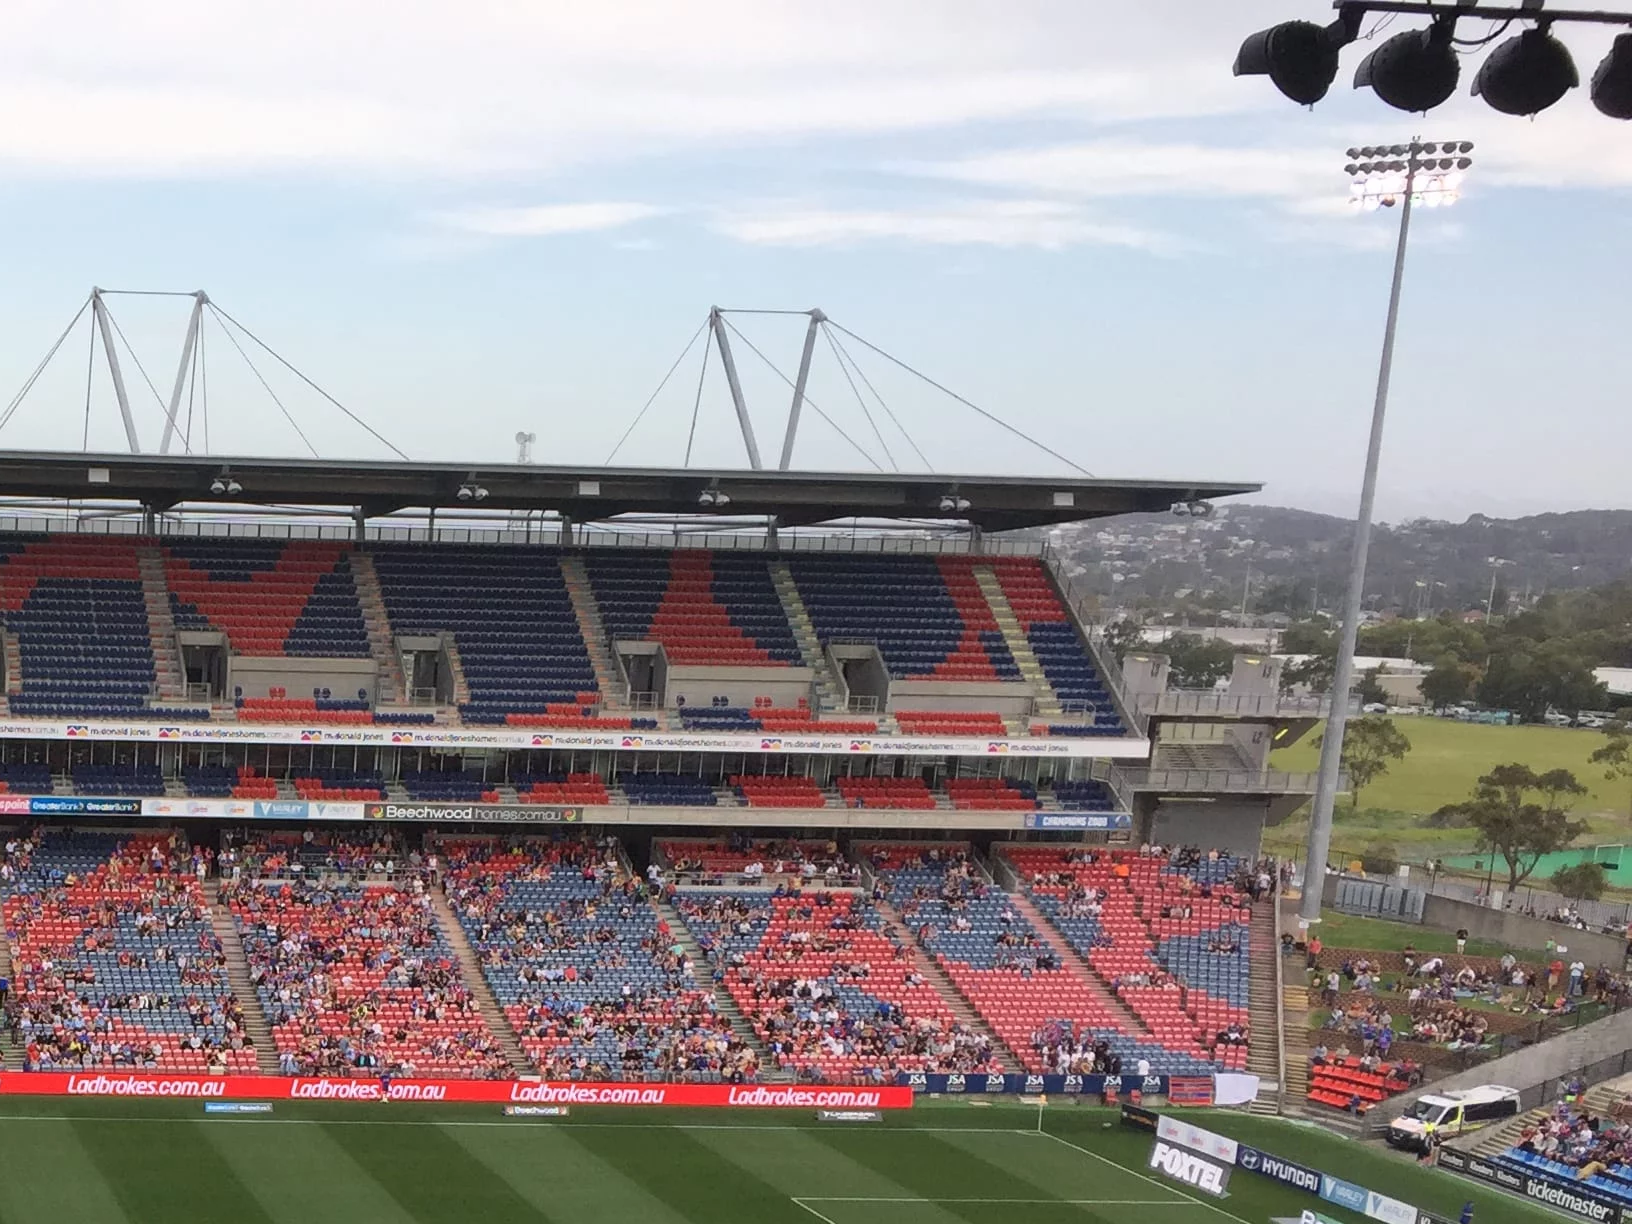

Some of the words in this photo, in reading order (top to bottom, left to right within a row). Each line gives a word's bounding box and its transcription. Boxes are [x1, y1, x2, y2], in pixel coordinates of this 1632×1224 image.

[386, 805, 472, 820] Beechwood
[908, 1074, 927, 1084] JSA
[947, 1075, 965, 1085] JSA
[986, 1075, 1005, 1085] JSA
[1025, 1075, 1044, 1085] JSA
[1065, 1075, 1083, 1085] JSA
[1103, 1075, 1122, 1085] JSA
[1142, 1075, 1161, 1085] JSA
[67, 1075, 225, 1096] Ladbrokes.com.au
[510, 1083, 665, 1103] Ladbrokes.com.au
[728, 1087, 880, 1107] Ladbrokes.com.au
[1150, 1142, 1223, 1194] FOXTEL
[1262, 1157, 1318, 1191] HYUNDAI
